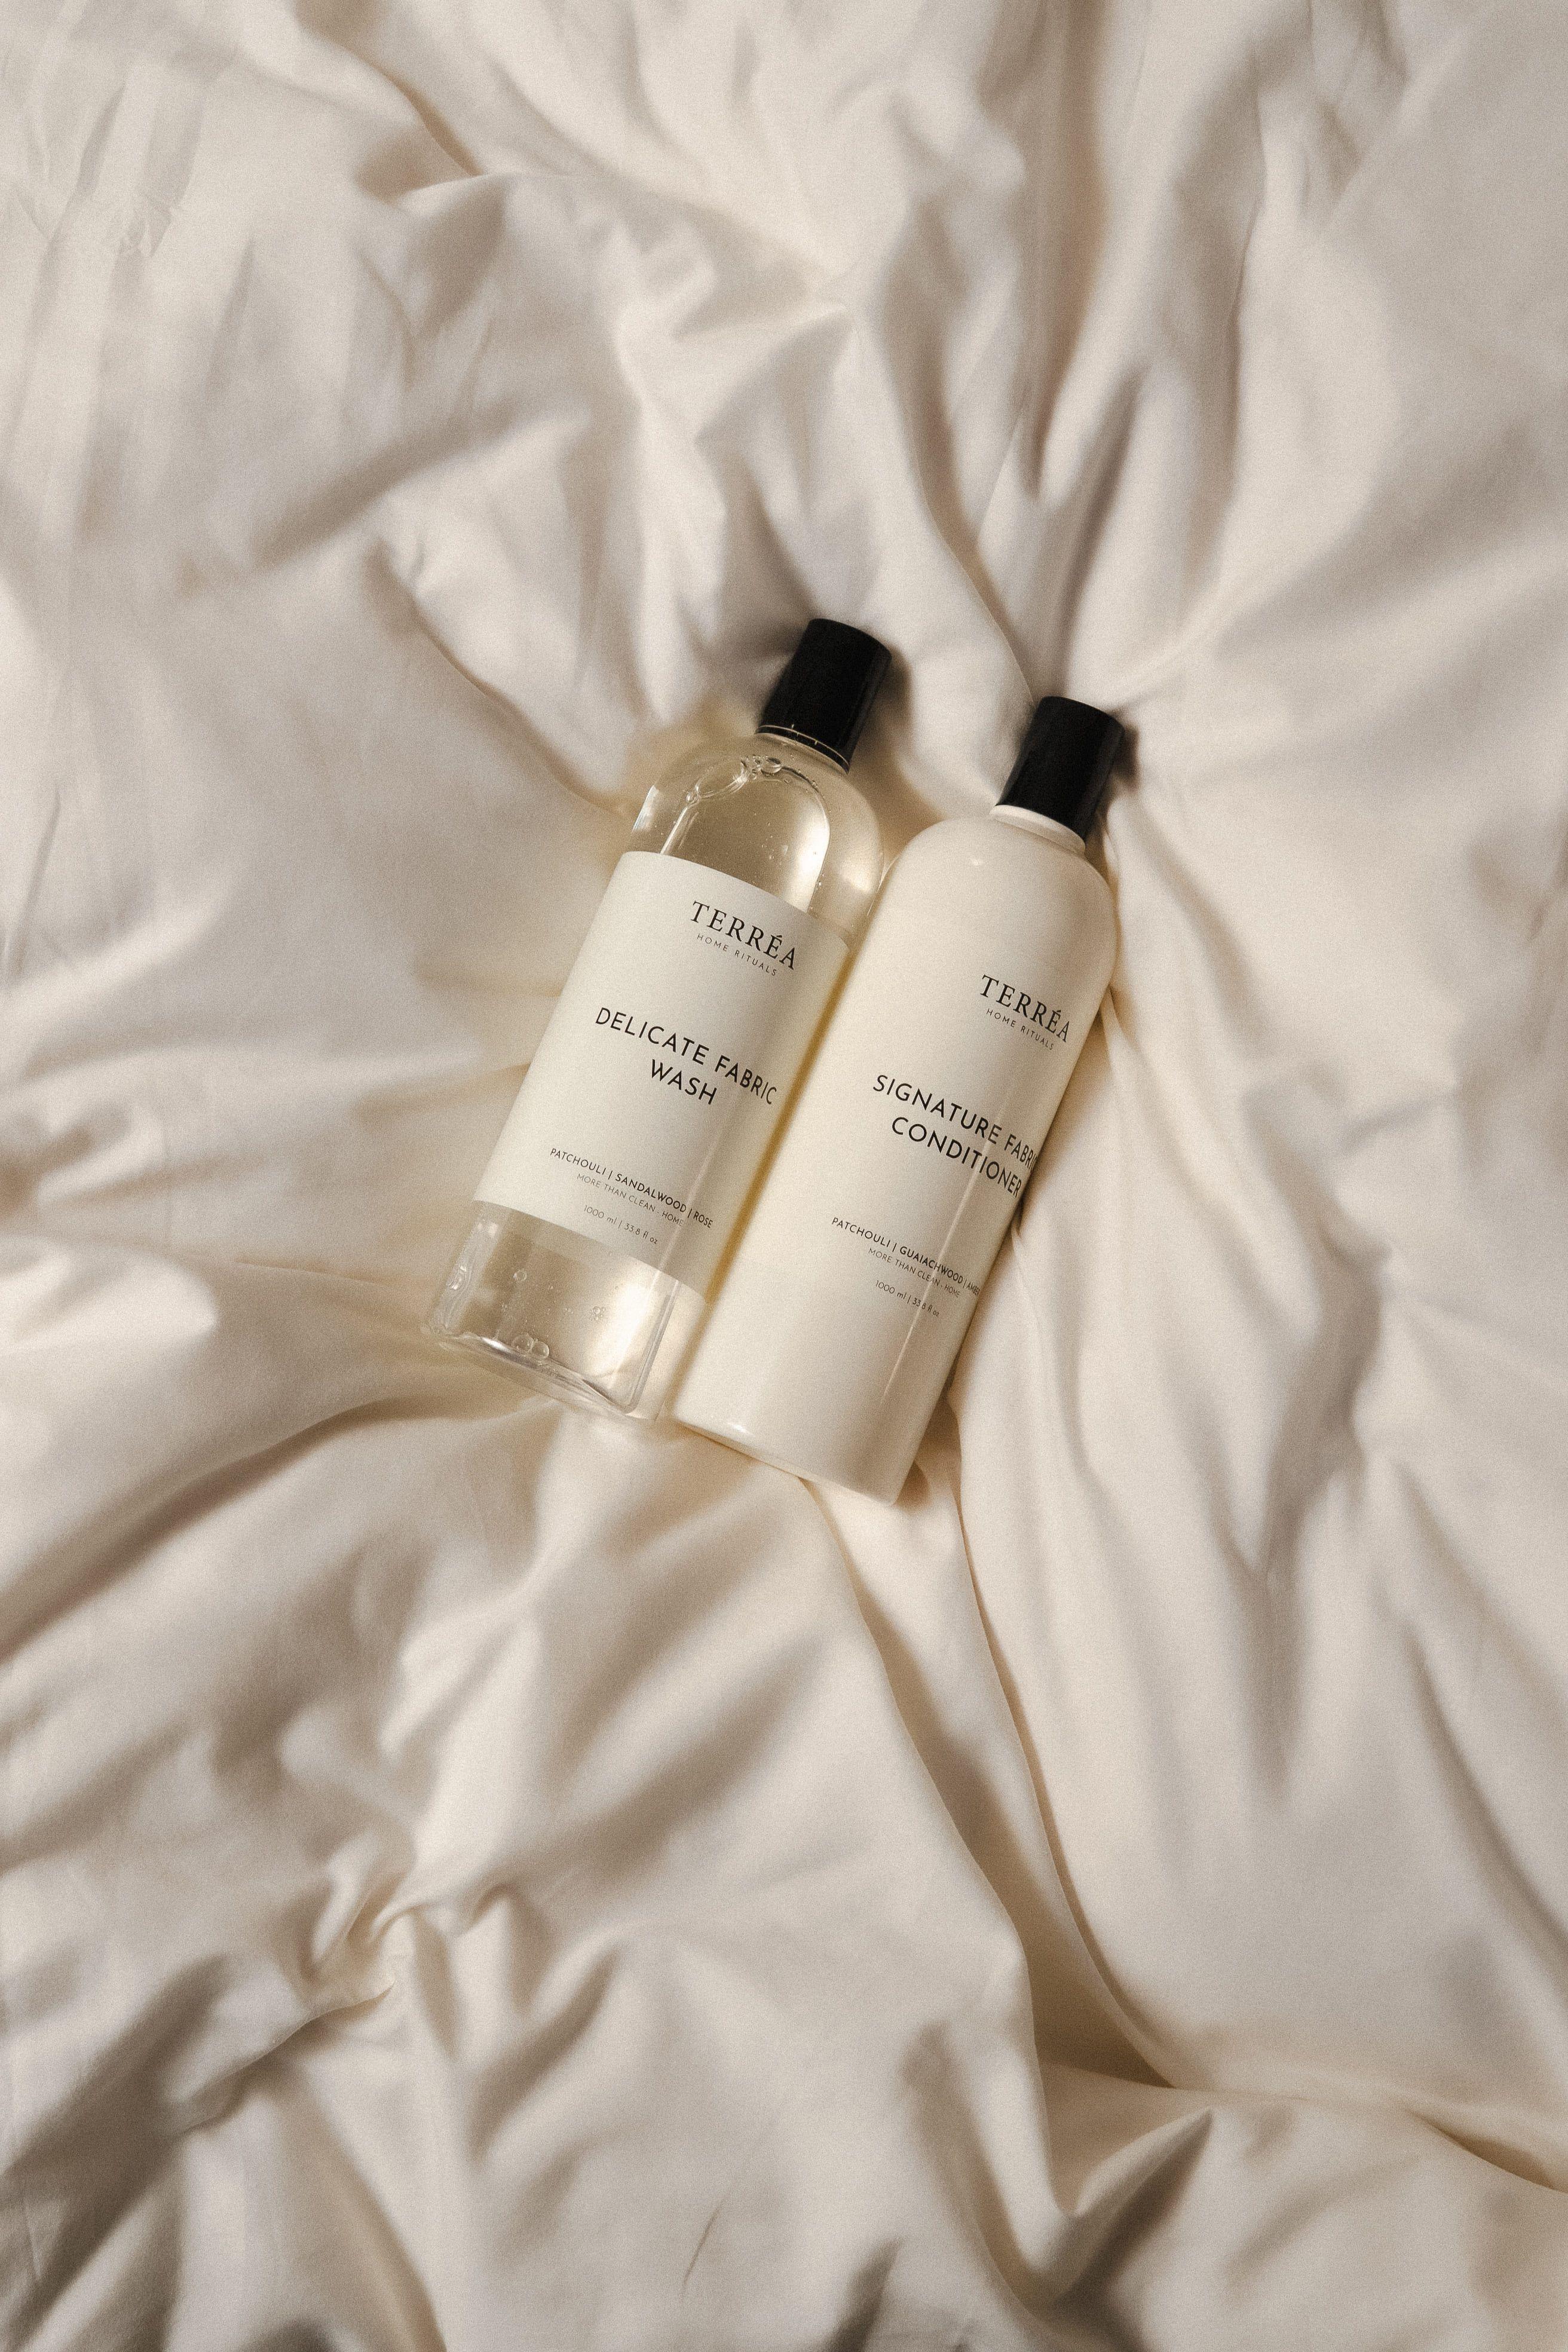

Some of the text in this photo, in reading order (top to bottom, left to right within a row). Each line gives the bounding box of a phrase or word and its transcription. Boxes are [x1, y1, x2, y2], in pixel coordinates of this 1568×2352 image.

[691, 901, 795, 970] TERRÉA
[697, 933, 777, 976] HOME RITUALS
[980, 974, 1070, 1042] TERRÉA
[986, 1008, 1054, 1051] HOME RITUALS
[595, 1007, 777, 1105] DELICATE FABRIC
[651, 1059, 717, 1105] WASH
[873, 1074, 1002, 1144] SIGNATURE
[892, 1117, 1022, 1198] CONDITIONER
[550, 1148, 607, 1175] PATCHOULI
[615, 1173, 687, 1212] SANDALWOOD
[693, 1211, 713, 1228] ROSE
[577, 1173, 684, 1226] MORE THAN CLEAN HOME
[583, 1205, 604, 1219] 1000
[606, 1216, 617, 1226] ml
[832, 1217, 891, 1248] PATCHOULI
[900, 1246, 963, 1284] GUAIACHWOOD
[868, 1247, 960, 1298] MORE THAN CLEAN HOME
[875, 1279, 895, 1294] 1000
[912, 1297, 926, 1309] 338
